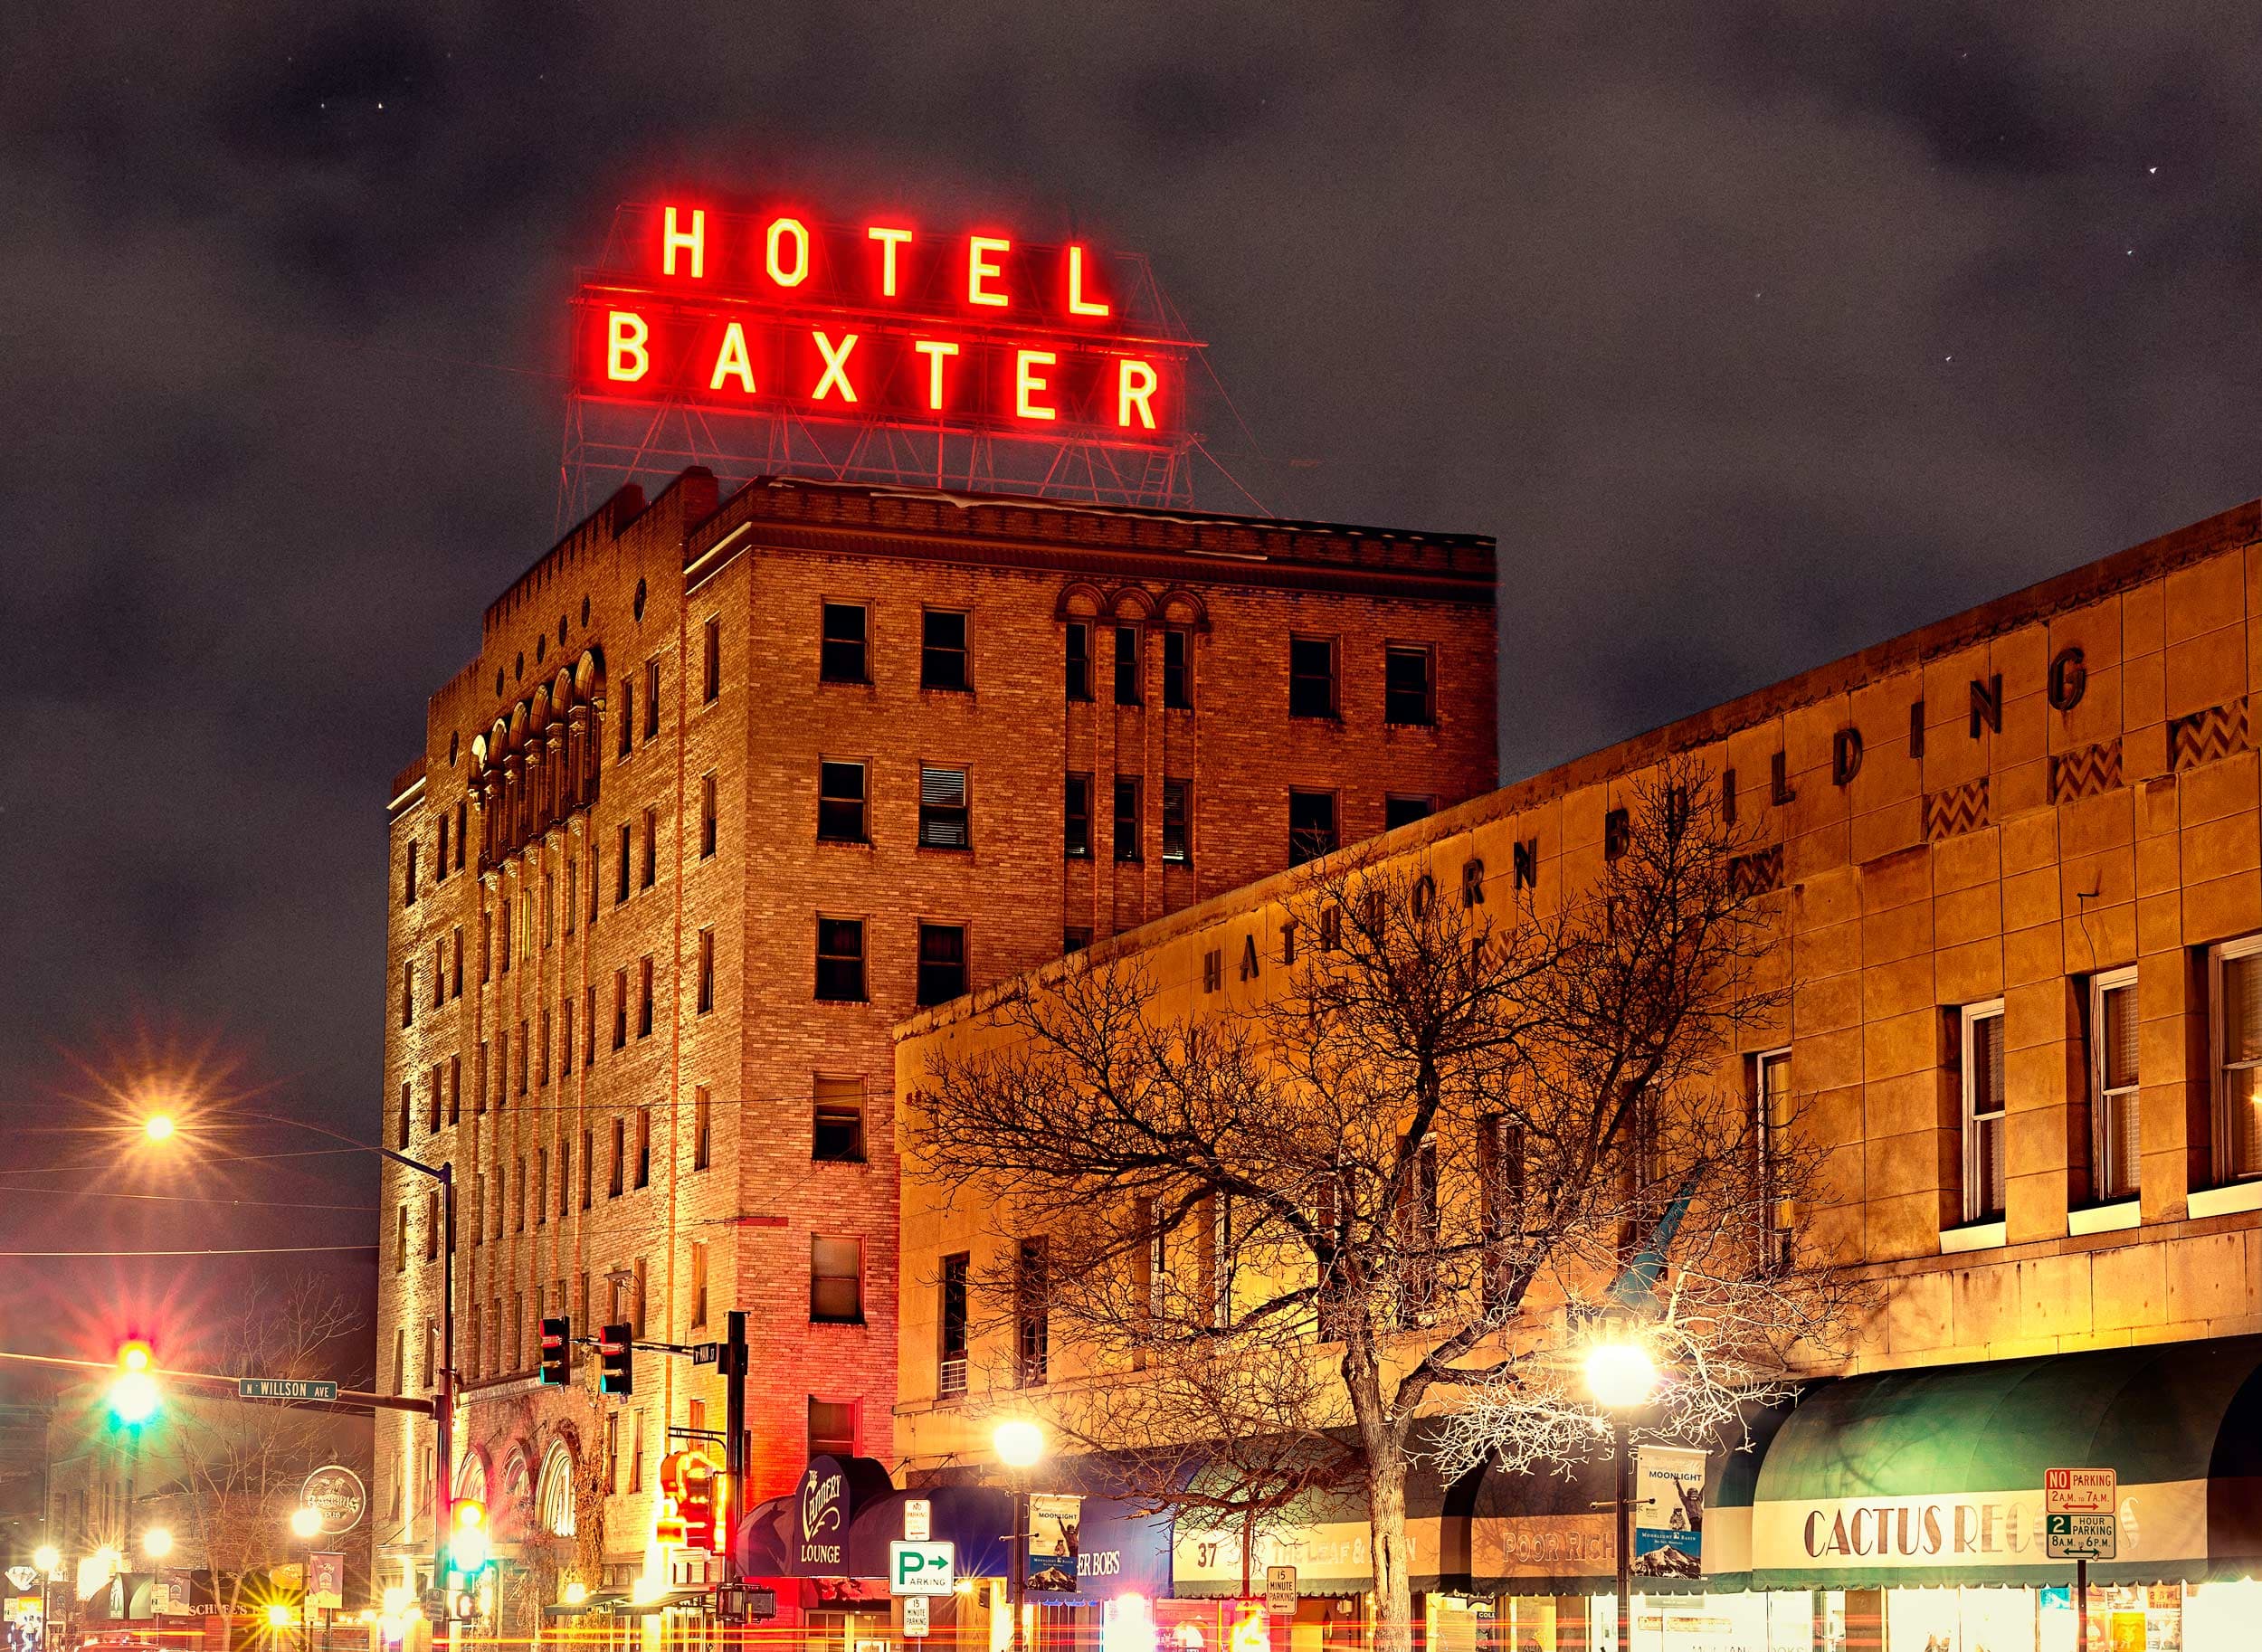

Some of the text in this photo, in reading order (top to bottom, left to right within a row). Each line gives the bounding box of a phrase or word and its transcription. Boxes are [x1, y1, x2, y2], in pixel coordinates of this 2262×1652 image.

[662, 205, 1110, 317] HOTEL
[606, 309, 1158, 430] BAXTER
[1604, 647, 2086, 862] BUILDING
[246, 1381, 329, 1398] N WILLSON AVE
[1649, 1471, 1703, 1482] MOONLIGHT
[2049, 1471, 2112, 1488] NO PARKING
[1038, 1512, 1078, 1520] MOONLIGHT
[2052, 1515, 2105, 1533] 2 HOUR
[1804, 1496, 2140, 1558] CACTUS RECOS
[2073, 1525, 2113, 1536] PARKING
[801, 1544, 841, 1563] LOUNGE
[1307, 1539, 1350, 1563] LEAF
[1352, 1538, 1365, 1564] &
[1503, 1531, 1616, 1562] POOR RICH
[1077, 1552, 1091, 1576] ER
[1197, 1543, 1217, 1568] 37
[1277, 1571, 1286, 1580] 15
[1269, 1581, 1293, 1590] MINUTE
[913, 1600, 920, 1608] 15
[1269, 1592, 1294, 1601] PARKING
[907, 1609, 926, 1617] MINUTE
[907, 1617, 927, 1626] PARKING
